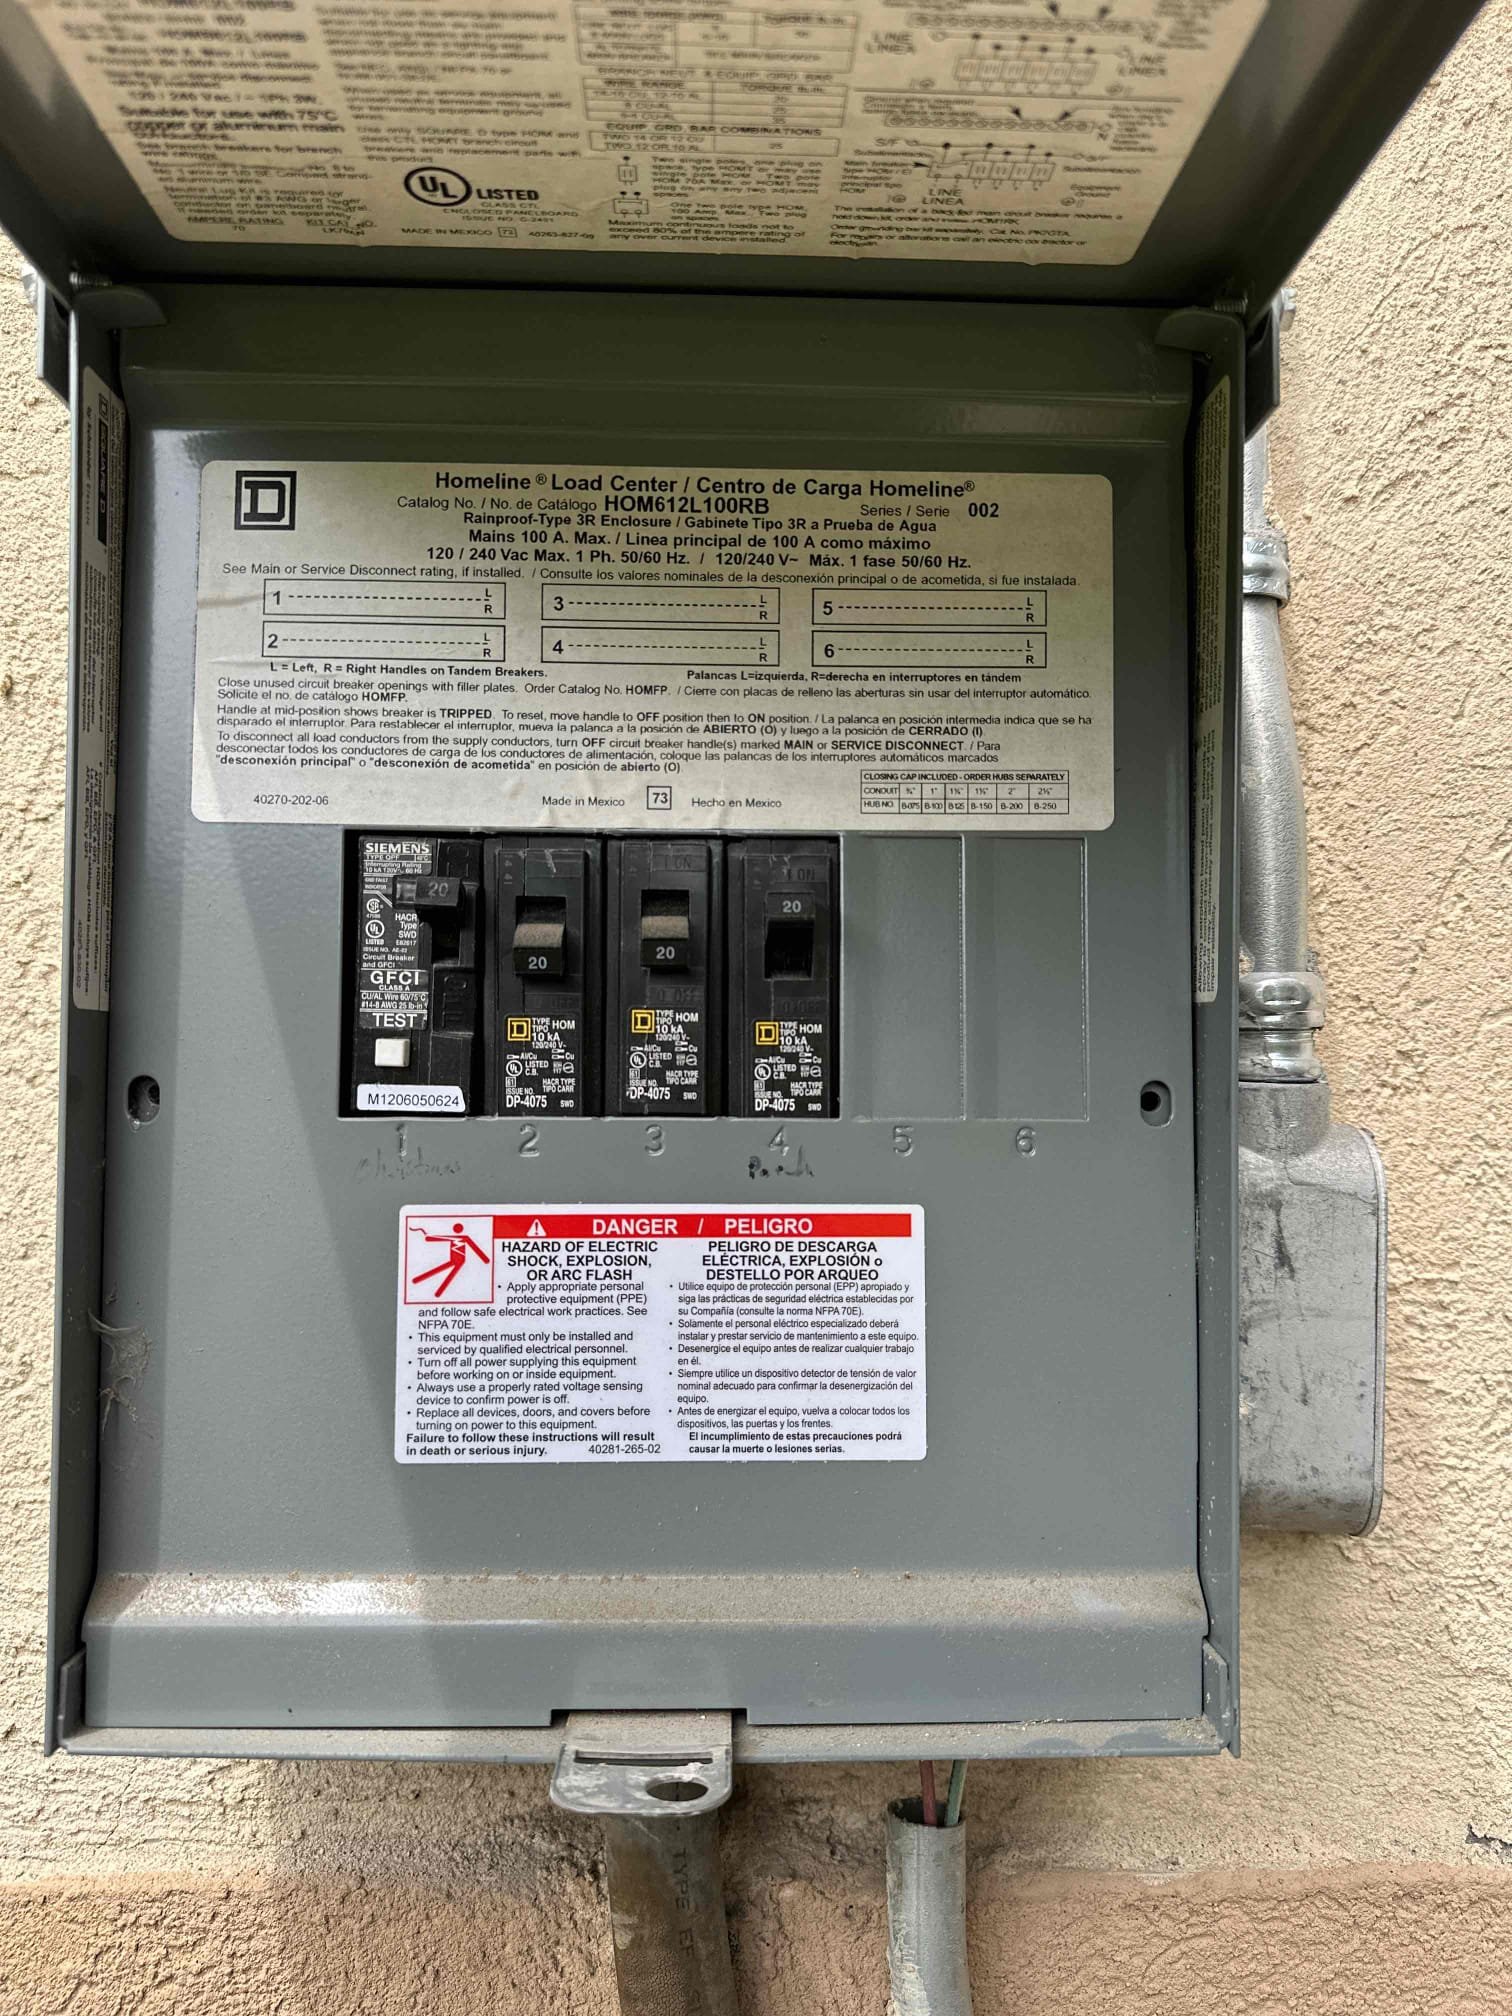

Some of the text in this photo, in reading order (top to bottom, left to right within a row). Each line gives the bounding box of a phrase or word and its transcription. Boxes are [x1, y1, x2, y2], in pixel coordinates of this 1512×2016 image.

[476, 188, 539, 201] LISTED
[929, 188, 962, 197] LINE
[922, 197, 965, 206] LINEA
[608, 219, 664, 228] Maximum
[666, 221, 725, 230] continuous
[728, 222, 757, 230] loads
[401, 227, 431, 235] MADE
[450, 228, 493, 236] MEXICO
[553, 475, 602, 490] Load
[610, 475, 677, 492] Center
[683, 476, 689, 493] /
[696, 476, 764, 494] Centro
[772, 478, 796, 494] de
[804, 478, 861, 498] Carga
[397, 496, 998, 517] Catalog No. / No. de Catálogo HOM612L100RB Series / Serie 002
[464, 513, 936, 534] Rainproof-Type 3R Enclosure / Gabinete Tipo 3R a Prueba de Agua
[469, 529, 515, 542] Mains
[521, 530, 547, 543] 100
[552, 530, 568, 543] A.
[574, 530, 610, 544] Max.
[615, 531, 620, 544] /
[673, 532, 741, 550] principal
[747, 534, 766, 547] de
[773, 535, 798, 548] 100
[804, 535, 815, 548] A
[820, 539, 863, 548] como
[868, 536, 930, 550] máximo
[427, 546, 453, 559] 120
[459, 547, 464, 560] /
[469, 547, 496, 560] 240
[500, 548, 528, 560] Vac
[534, 548, 569, 562] Max.
[576, 550, 582, 562] 1
[590, 550, 615, 563] Ph.
[621, 550, 661, 563] 50/60
[667, 551, 689, 564] Hz.
[700, 552, 704, 564] /
[716, 552, 774, 565] 120/240
[809, 554, 844, 566] Máx.
[850, 554, 855, 566] 1
[863, 554, 895, 567] fase
[901, 555, 942, 568] 50/60
[948, 555, 970, 568] Hz.
[273, 591, 282, 605] 1
[553, 597, 564, 611] 3
[823, 601, 833, 616] 5
[267, 634, 278, 648] 2
[552, 640, 563, 654] 4
[824, 644, 834, 658] 6
[217, 689, 258, 699] Solicite
[261, 690, 271, 699] el
[294, 690, 309, 700] de
[312, 691, 358, 703] catálogo
[253, 794, 329, 805] 40270-202-06
[542, 795, 624, 806] Made in Mexico
[652, 792, 668, 804] 73
[691, 797, 782, 807] Hecho en Mexico
[365, 842, 430, 854] SIEMENS
[428, 882, 448, 897] 20
[783, 900, 802, 913] 20
[395, 913, 418, 921] HACR
[400, 921, 417, 930] Type
[398, 930, 417, 938] SWD
[656, 947, 676, 960] 20
[528, 957, 548, 970] 20
[370, 970, 419, 985] GFCI
[372, 1012, 418, 1028] TEST
[532, 1017, 550, 1025] TYPE
[675, 1012, 699, 1022] HOM
[552, 1020, 576, 1030] HOM
[656, 1024, 684, 1034] 10 kA
[800, 1024, 823, 1034] HOM
[532, 1032, 560, 1041] 10 kA
[565, 1052, 575, 1060] Cu
[648, 1052, 672, 1060] LISTED
[525, 1060, 549, 1068] LISTED
[525, 1068, 539, 1076] C.B.
[542, 1078, 576, 1086] HACR TYPE
[368, 1093, 459, 1106] M1206050624
[629, 1087, 671, 1100] DP-4075
[506, 1095, 547, 1108] DP-4075
[560, 1100, 574, 1108] SWD
[755, 1098, 796, 1111] DP-4075
[395, 1122, 408, 1157] 1
[519, 1123, 541, 1157] 2
[644, 1124, 666, 1157] 3
[769, 1125, 790, 1157] 4
[893, 1125, 914, 1157] 5
[1015, 1126, 1037, 1159] 6
[592, 1218, 814, 1236] DANGER / PELIGRO
[502, 1240, 657, 1252] HAZARD OF ELECTRIC
[708, 1240, 877, 1254] PELIGRO DE DESCARGA
[507, 1255, 651, 1268] SHOCK, EXPLOSION,
[702, 1252, 882, 1268] ELÉCTRICA, EXPLOSIÓN o
[526, 1269, 631, 1282] OR ARC FLASH
[706, 1269, 878, 1282] DESTELLO POR ARQUEO
[506, 1281, 645, 1294] Apply appropriate personal
[406, 1431, 658, 1444] Failure to follow these instructions will result
[588, 1444, 661, 1455] 40281-265-02
